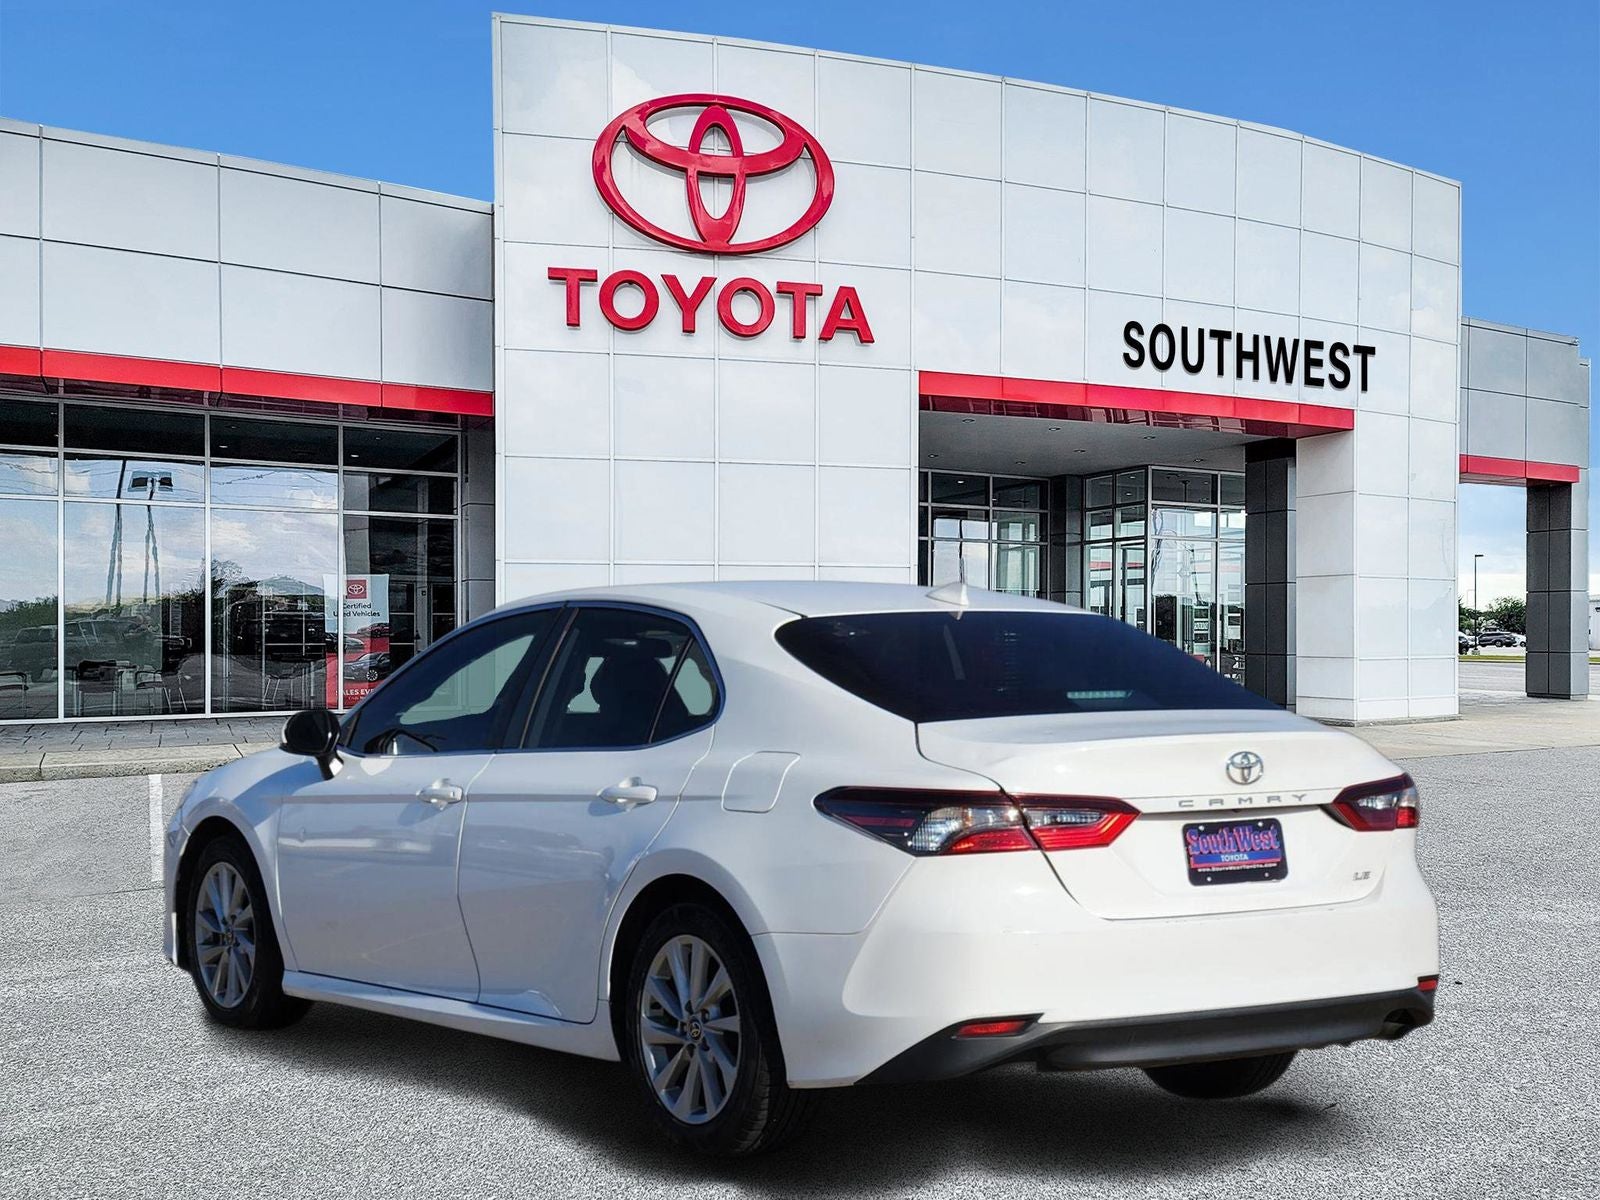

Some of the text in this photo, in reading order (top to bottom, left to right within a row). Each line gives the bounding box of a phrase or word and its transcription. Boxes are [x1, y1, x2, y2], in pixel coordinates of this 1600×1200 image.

[548, 266, 875, 344] TOYOTA
[1122, 320, 1376, 392] SOUTHWEST
[332, 610, 380, 618] Ued Vehicles
[1178, 793, 1307, 808] CAMRY
[1220, 853, 1249, 862] TOYOTA
[1353, 870, 1371, 881] LE
